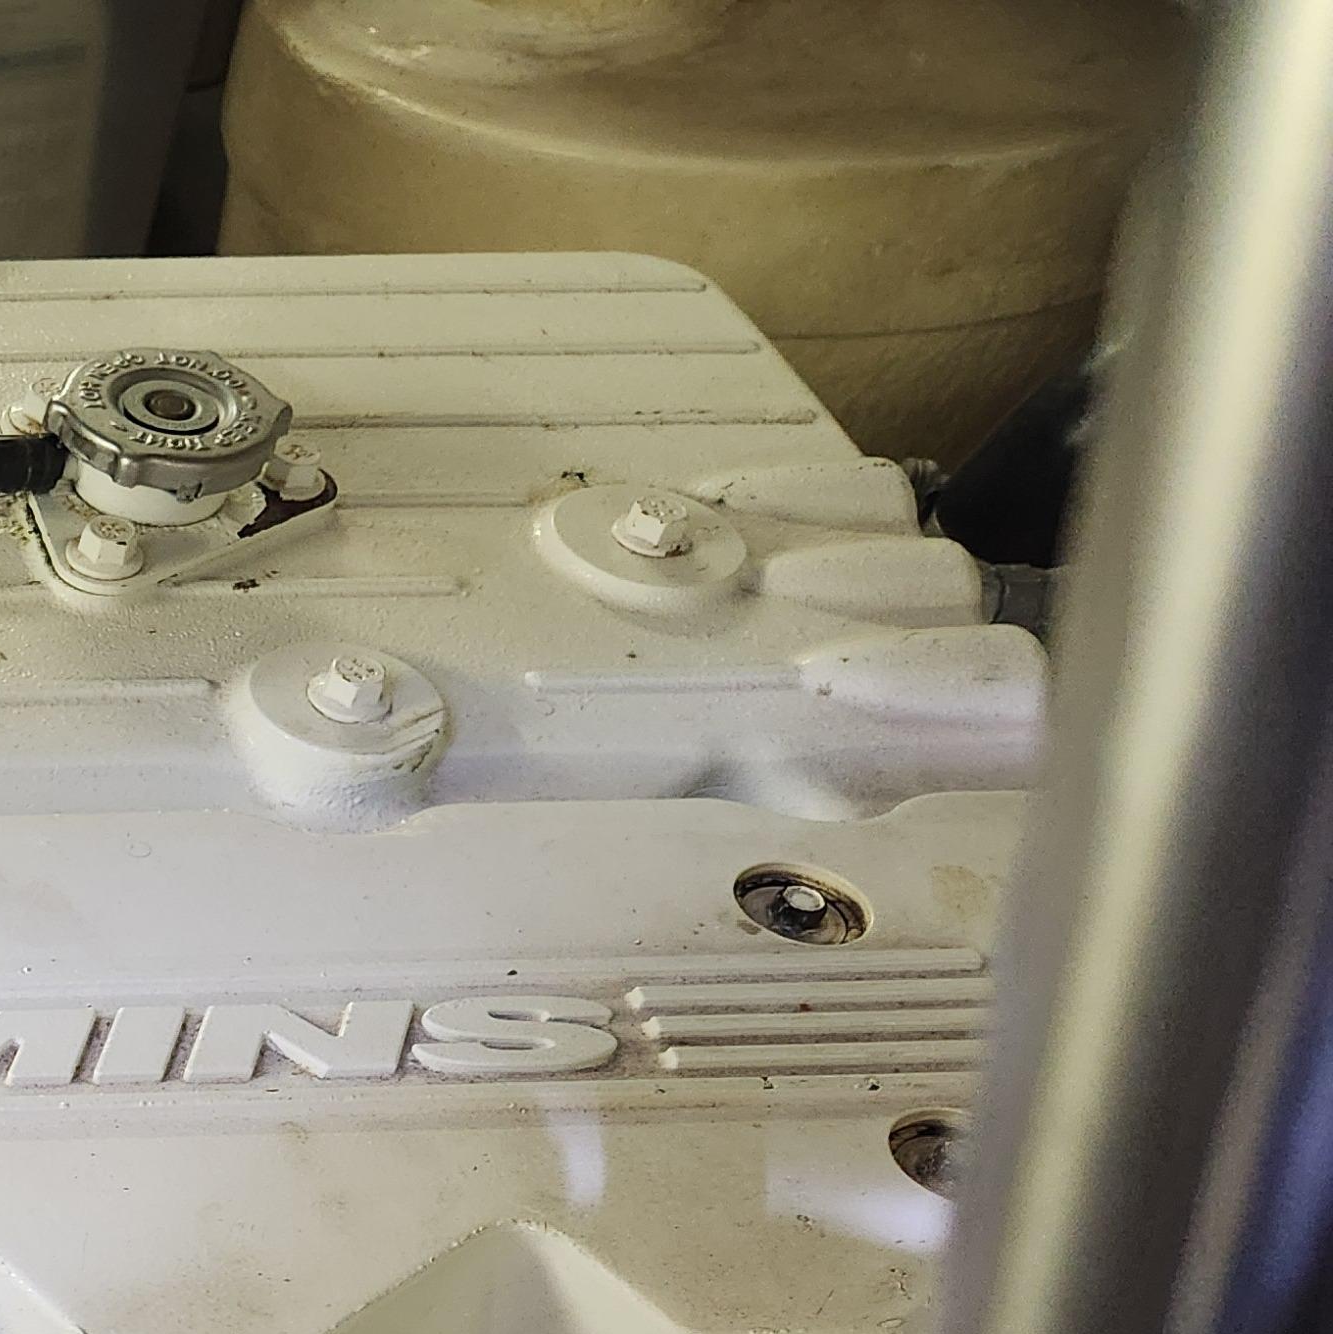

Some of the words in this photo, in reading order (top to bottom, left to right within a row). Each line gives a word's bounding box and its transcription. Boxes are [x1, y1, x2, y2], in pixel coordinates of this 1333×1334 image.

[155, 352, 209, 371] NOT
[79, 379, 106, 410] HOT
[129, 431, 208, 451] TIGHT
